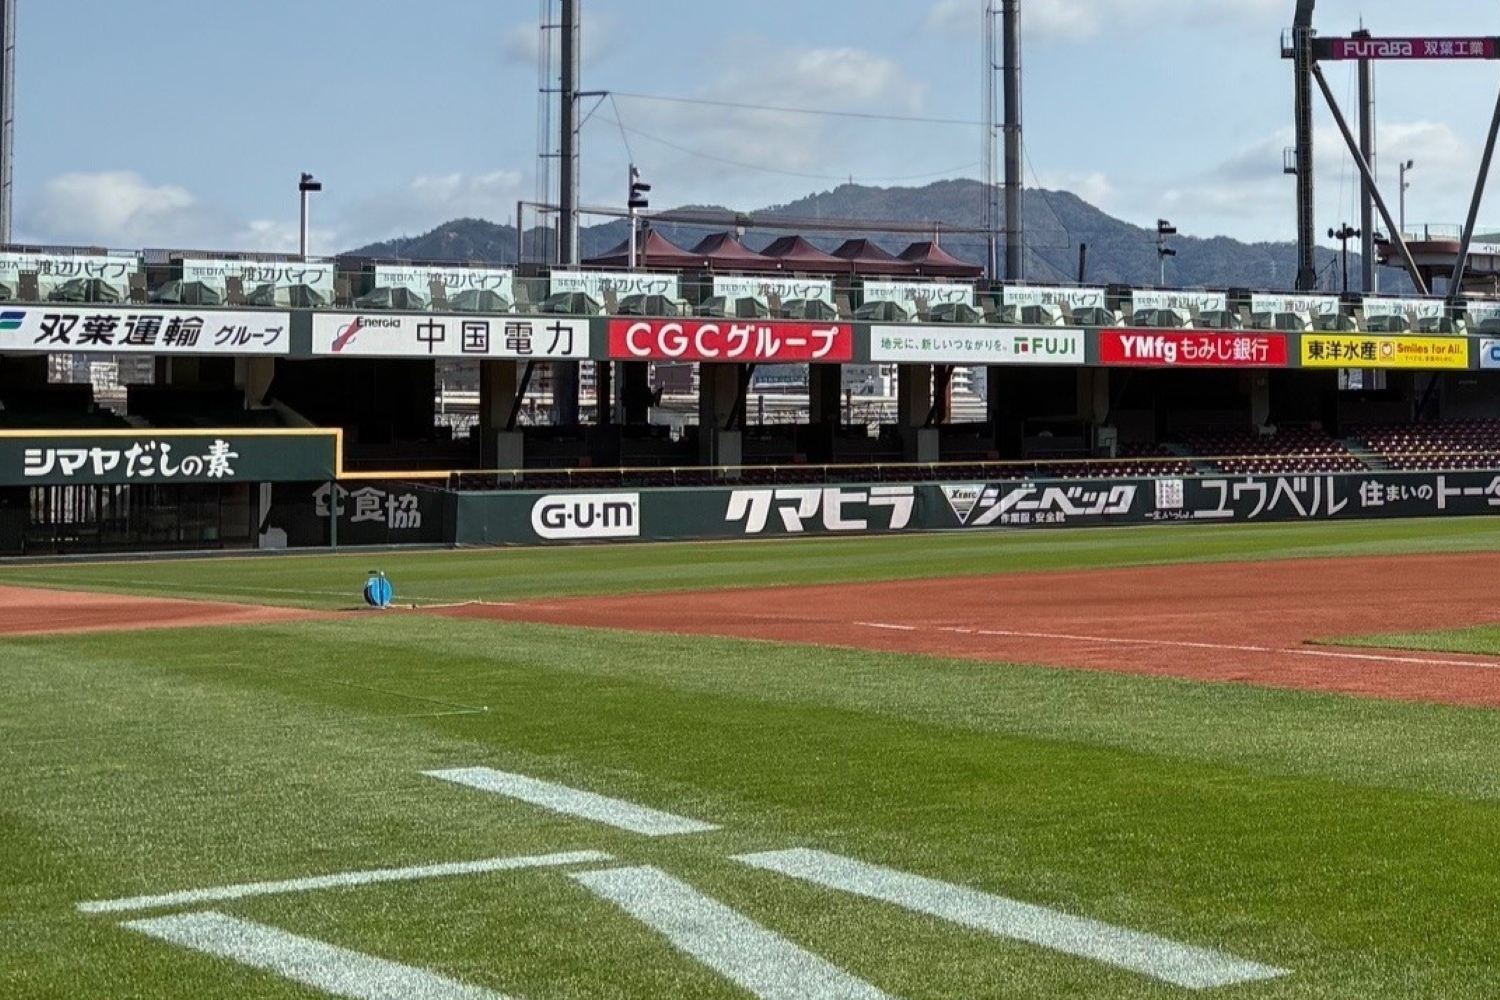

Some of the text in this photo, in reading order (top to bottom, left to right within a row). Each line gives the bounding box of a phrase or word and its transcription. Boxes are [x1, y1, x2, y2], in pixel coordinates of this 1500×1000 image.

[34, 314, 284, 347] 双葉運輸 グループ
[416, 317, 575, 356] 中国電力
[626, 321, 840, 359] CGCグループ
[1032, 337, 1076, 355] FUJI
[1119, 335, 1269, 364] YMfg もみじ銀行
[1308, 340, 1377, 361] 東洋水産
[1397, 342, 1429, 355] Smiles
[1432, 343, 1446, 355] for
[24, 439, 239, 479] シマヤだしの素
[350, 486, 422, 529] 食協
[725, 487, 915, 533] クマヒラ
[1194, 476, 1348, 519] ユウベル
[1359, 481, 1433, 507] 住まいの
